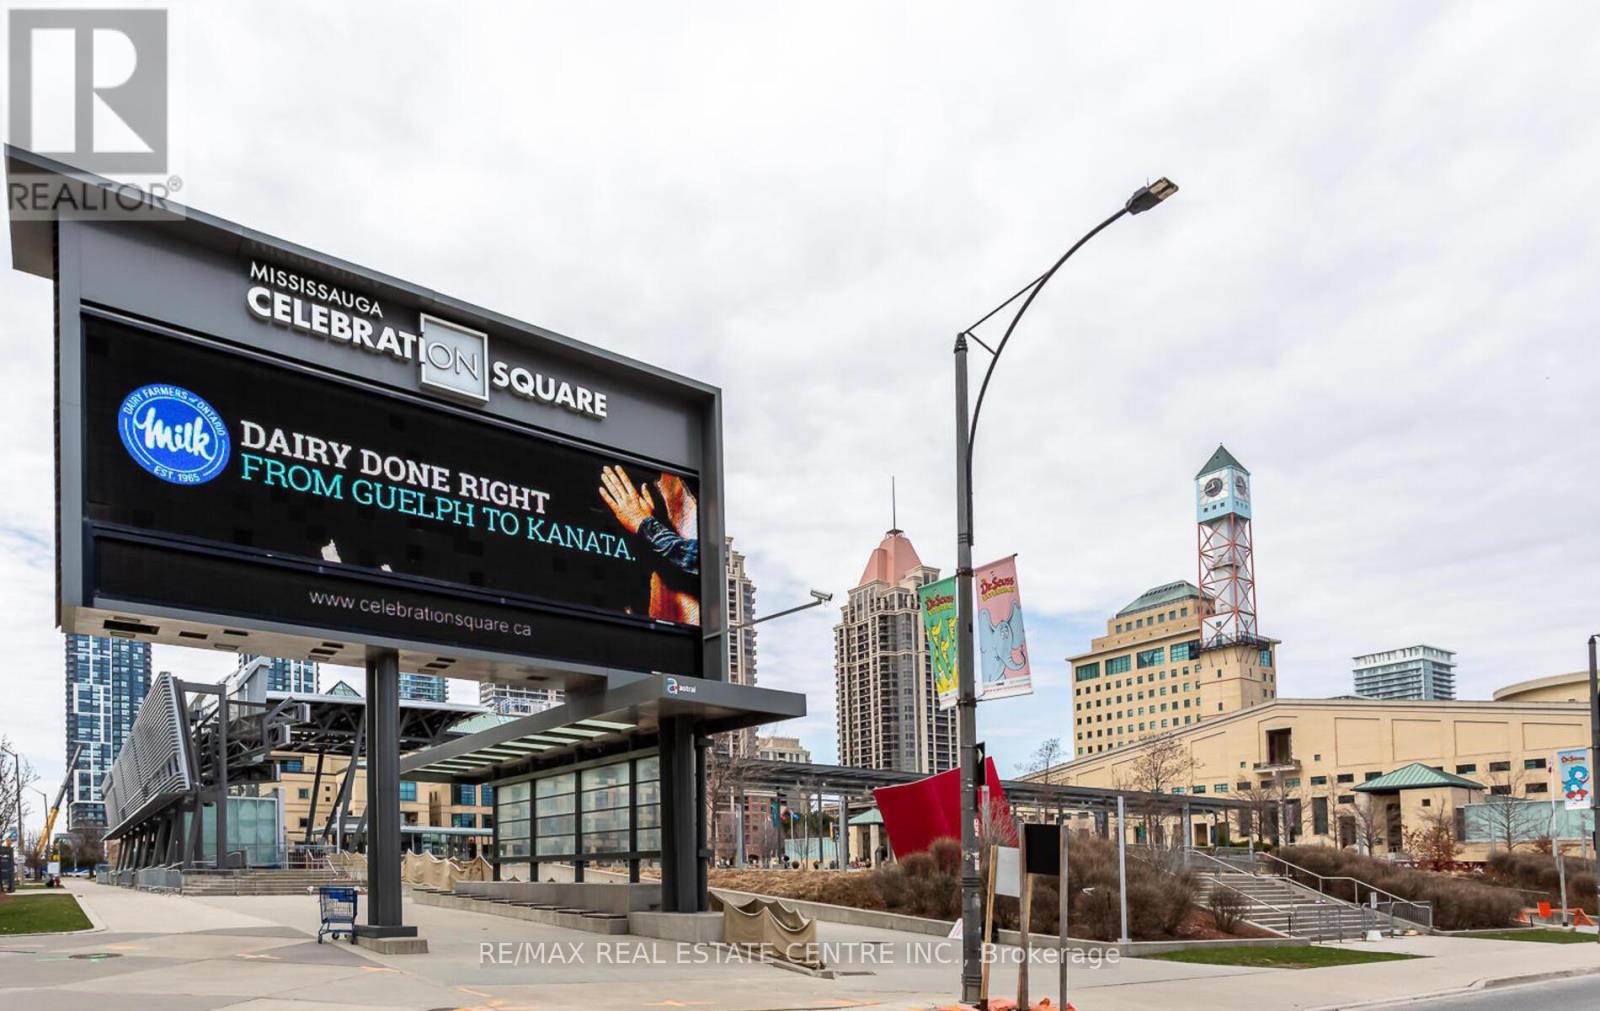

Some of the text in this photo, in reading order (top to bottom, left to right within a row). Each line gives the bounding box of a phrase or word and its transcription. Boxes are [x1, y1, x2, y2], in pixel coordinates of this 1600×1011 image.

[249, 261, 384, 319] MISSISSAUGA
[247, 286, 608, 420] CELEBRATION SQUARE
[123, 393, 144, 415] DAIRY
[142, 387, 189, 400] FARMERS
[196, 401, 226, 436] ONTARIO
[177, 473, 201, 482] 1965
[240, 420, 550, 515] DAIRY DONE RIGHT
[240, 453, 636, 562] FROM GUELPH TO KANATA.
